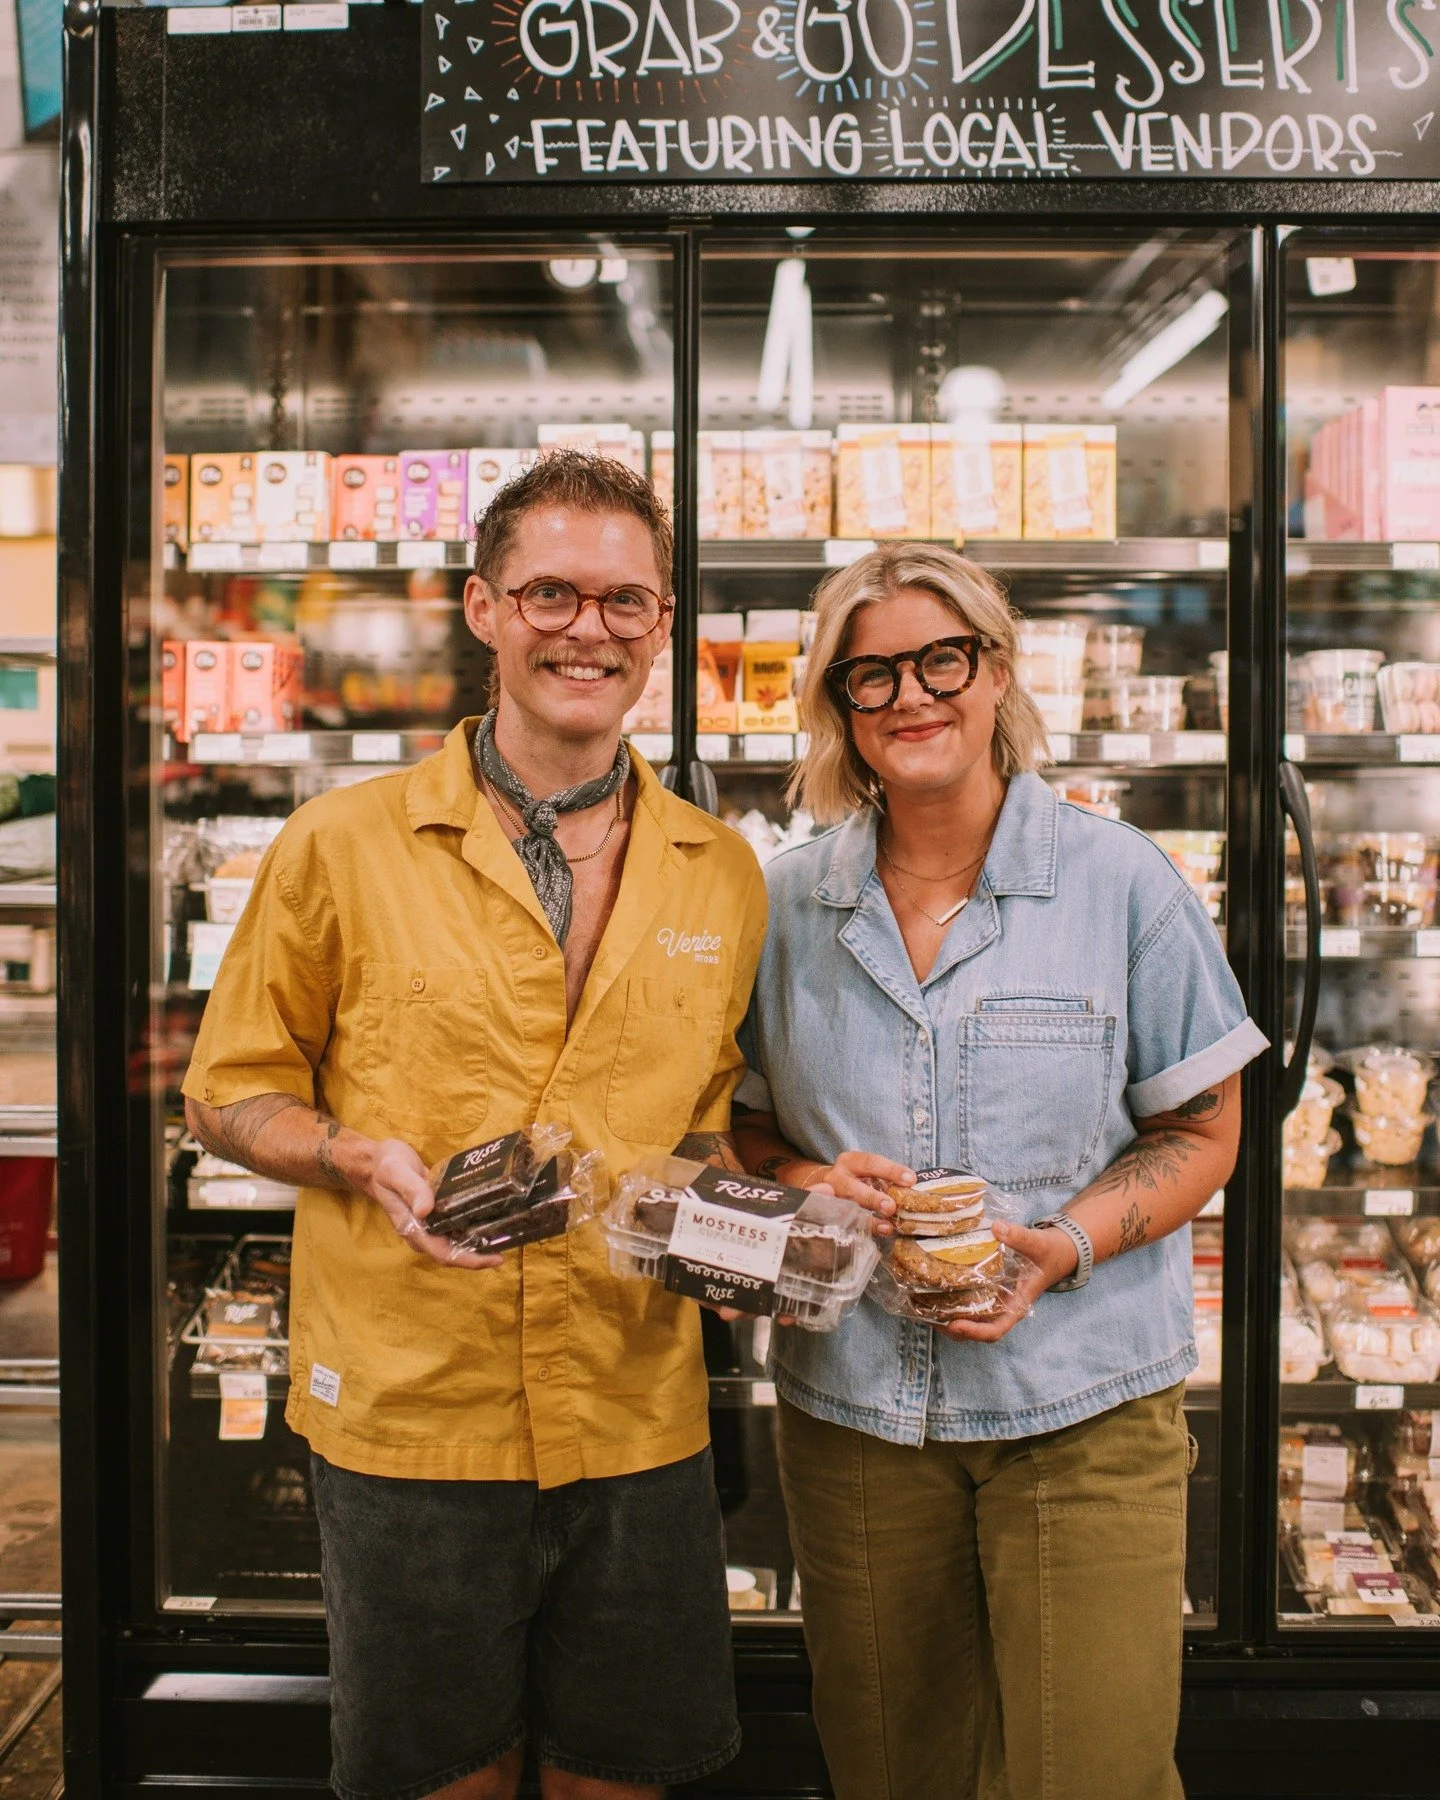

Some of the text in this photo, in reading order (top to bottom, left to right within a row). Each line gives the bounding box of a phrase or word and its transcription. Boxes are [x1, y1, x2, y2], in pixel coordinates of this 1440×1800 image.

[519, 0, 741, 78] GRAB
[751, 5, 791, 59] &
[794, 0, 914, 82] GO
[530, 108, 1378, 175] FEATURING LOCAL VENDORS
[657, 928, 721, 958] Venice
[463, 1139, 505, 1169] RISE
[917, 1167, 949, 1181] RISE
[714, 1180, 784, 1201] RISE
[692, 1214, 769, 1242] MOSTESS
[705, 1284, 736, 1301] RISE
